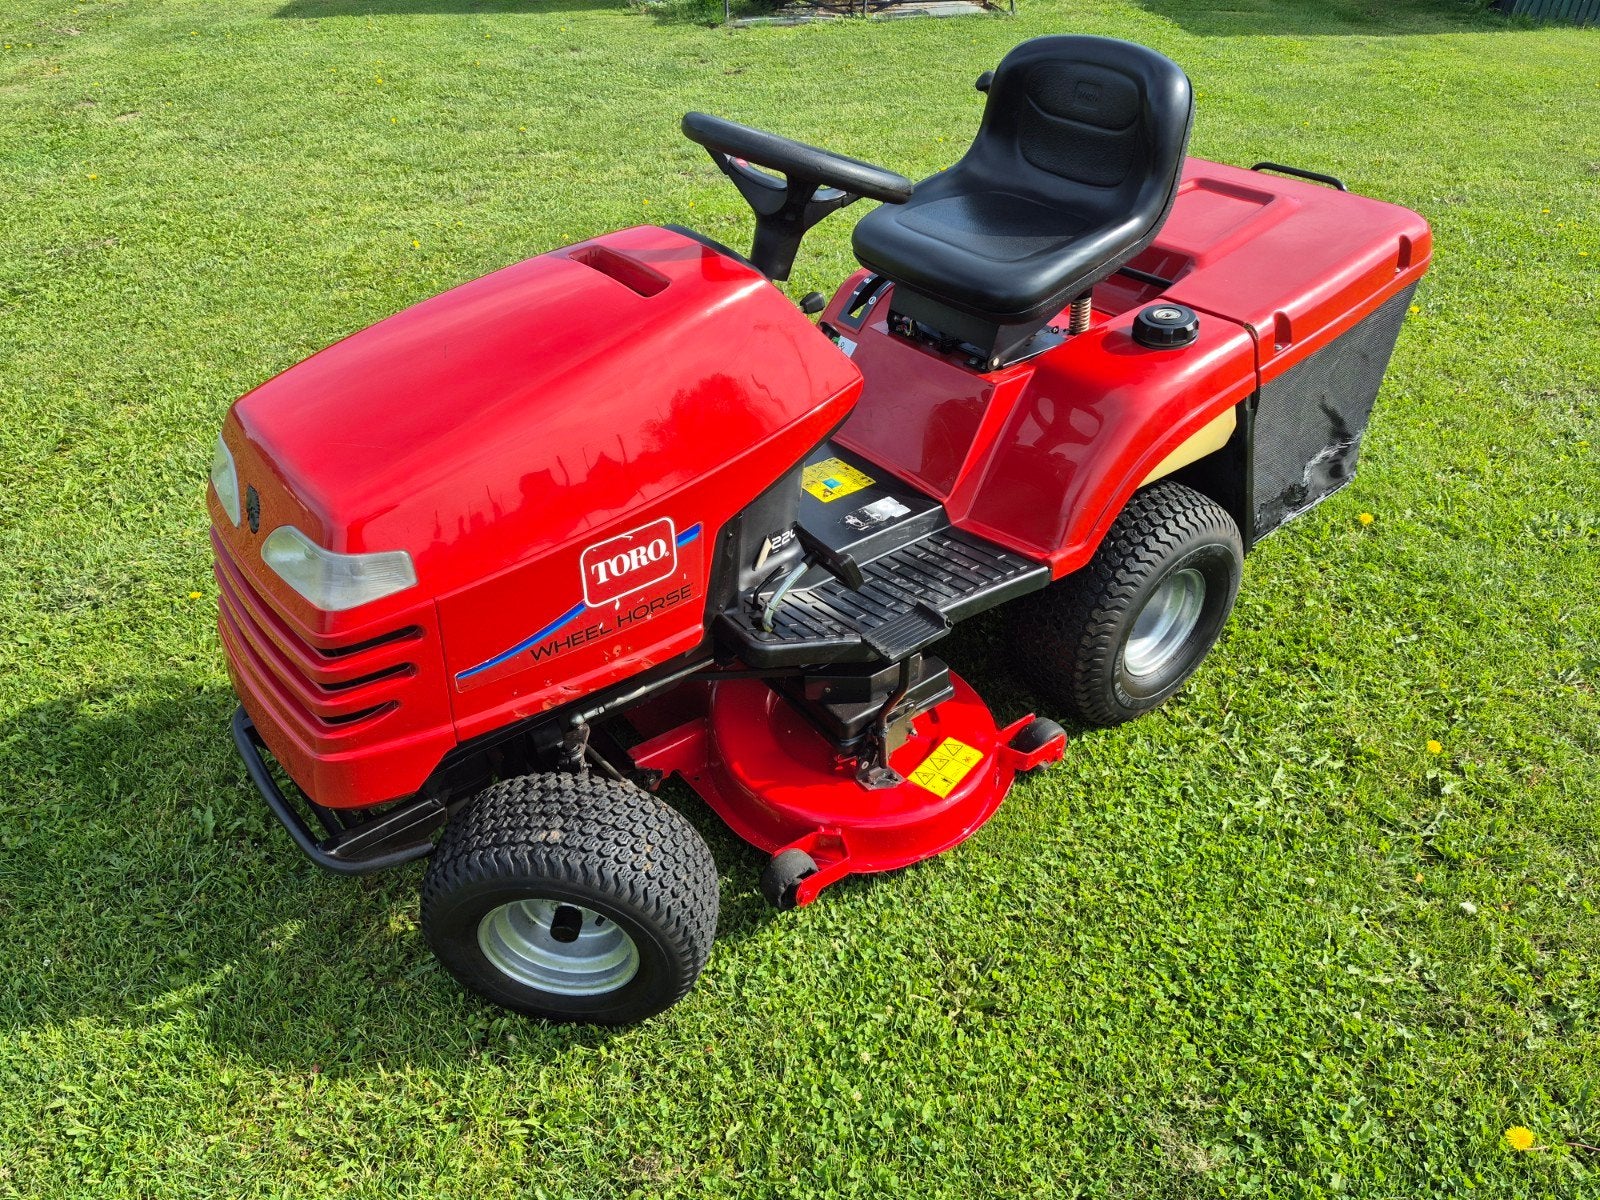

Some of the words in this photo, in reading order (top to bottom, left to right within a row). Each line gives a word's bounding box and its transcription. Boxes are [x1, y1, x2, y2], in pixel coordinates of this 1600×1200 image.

[591, 538, 667, 585] TORO
[530, 623, 613, 661] WHEEL
[617, 584, 692, 628] HORSE
